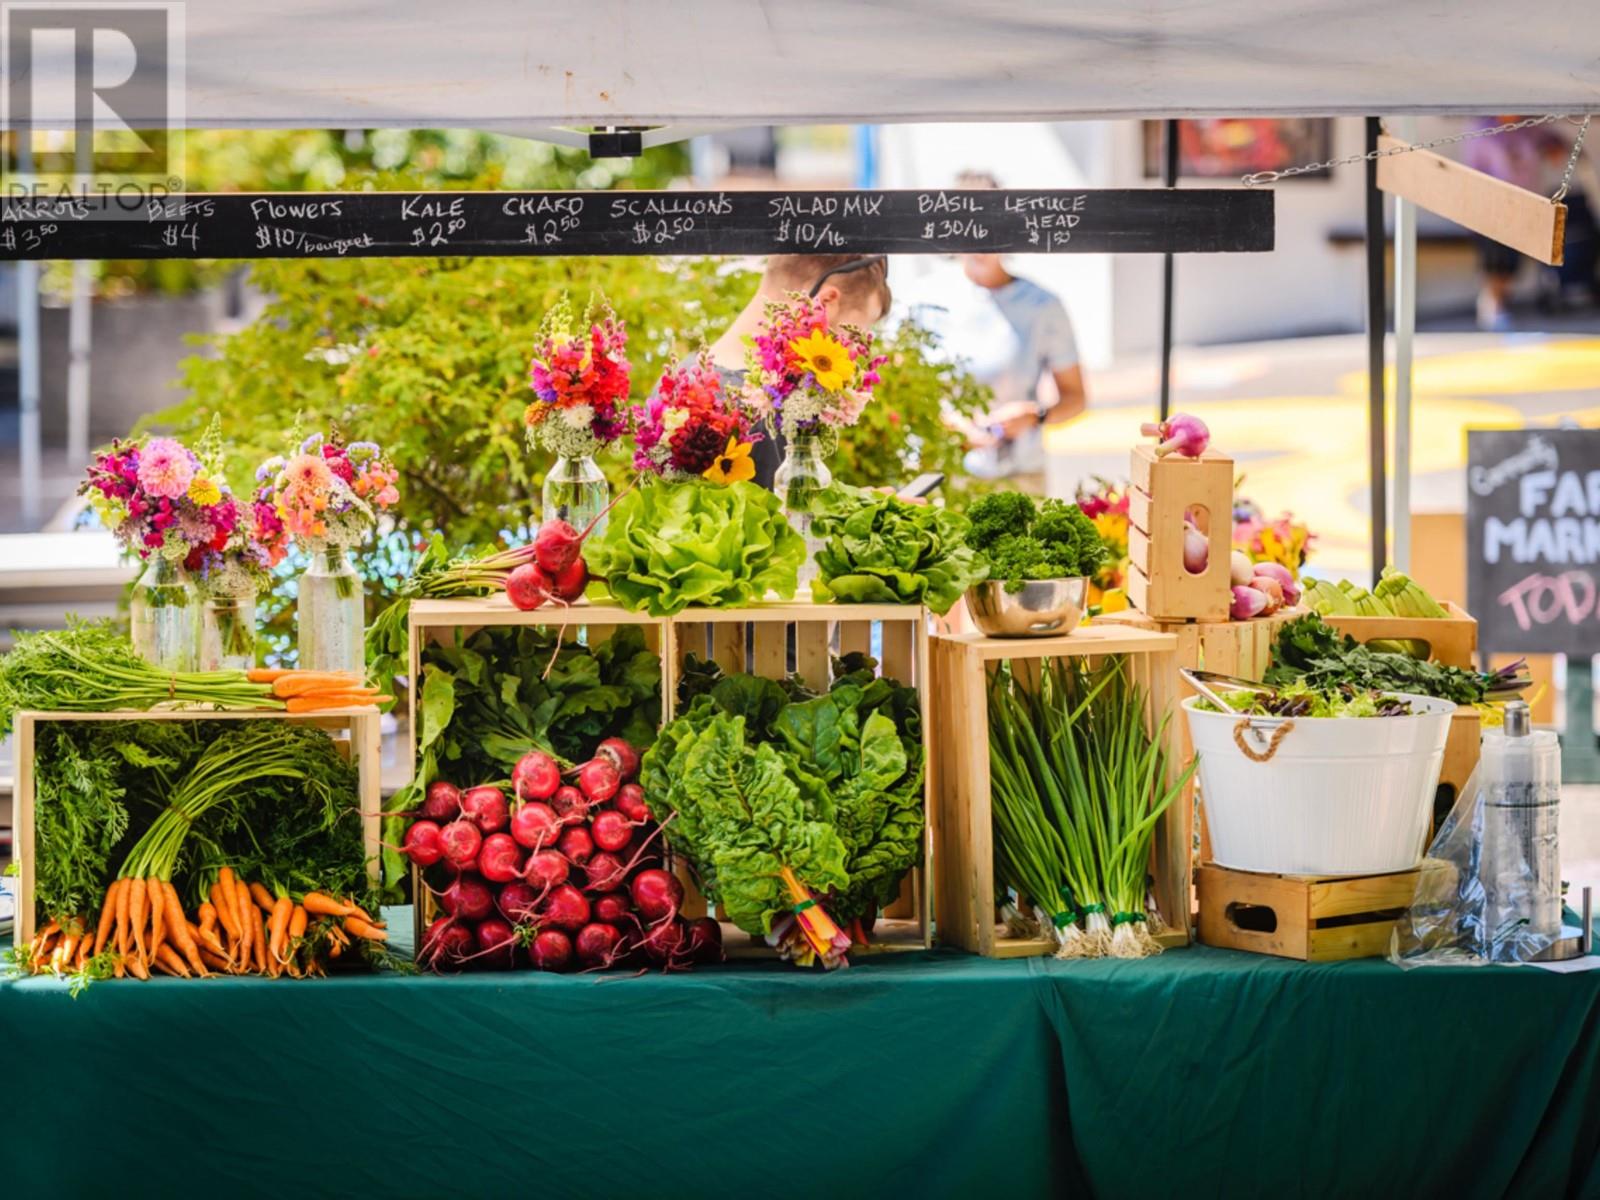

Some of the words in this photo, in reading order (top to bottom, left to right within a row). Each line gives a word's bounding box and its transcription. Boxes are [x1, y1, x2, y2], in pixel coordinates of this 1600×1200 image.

[146, 200, 216, 223] BEETS
[250, 199, 343, 220] Flowers
[401, 195, 465, 220] KALE
[502, 196, 585, 216] CHARD
[610, 192, 733, 218] SCALLIONS
[768, 196, 838, 218] SALAD
[842, 195, 884, 217] MIX
[918, 191, 984, 213] BASIL
[1004, 195, 1088, 213] LETTUCE
[1025, 214, 1081, 230] HEAD
[162, 223, 200, 251] $4
